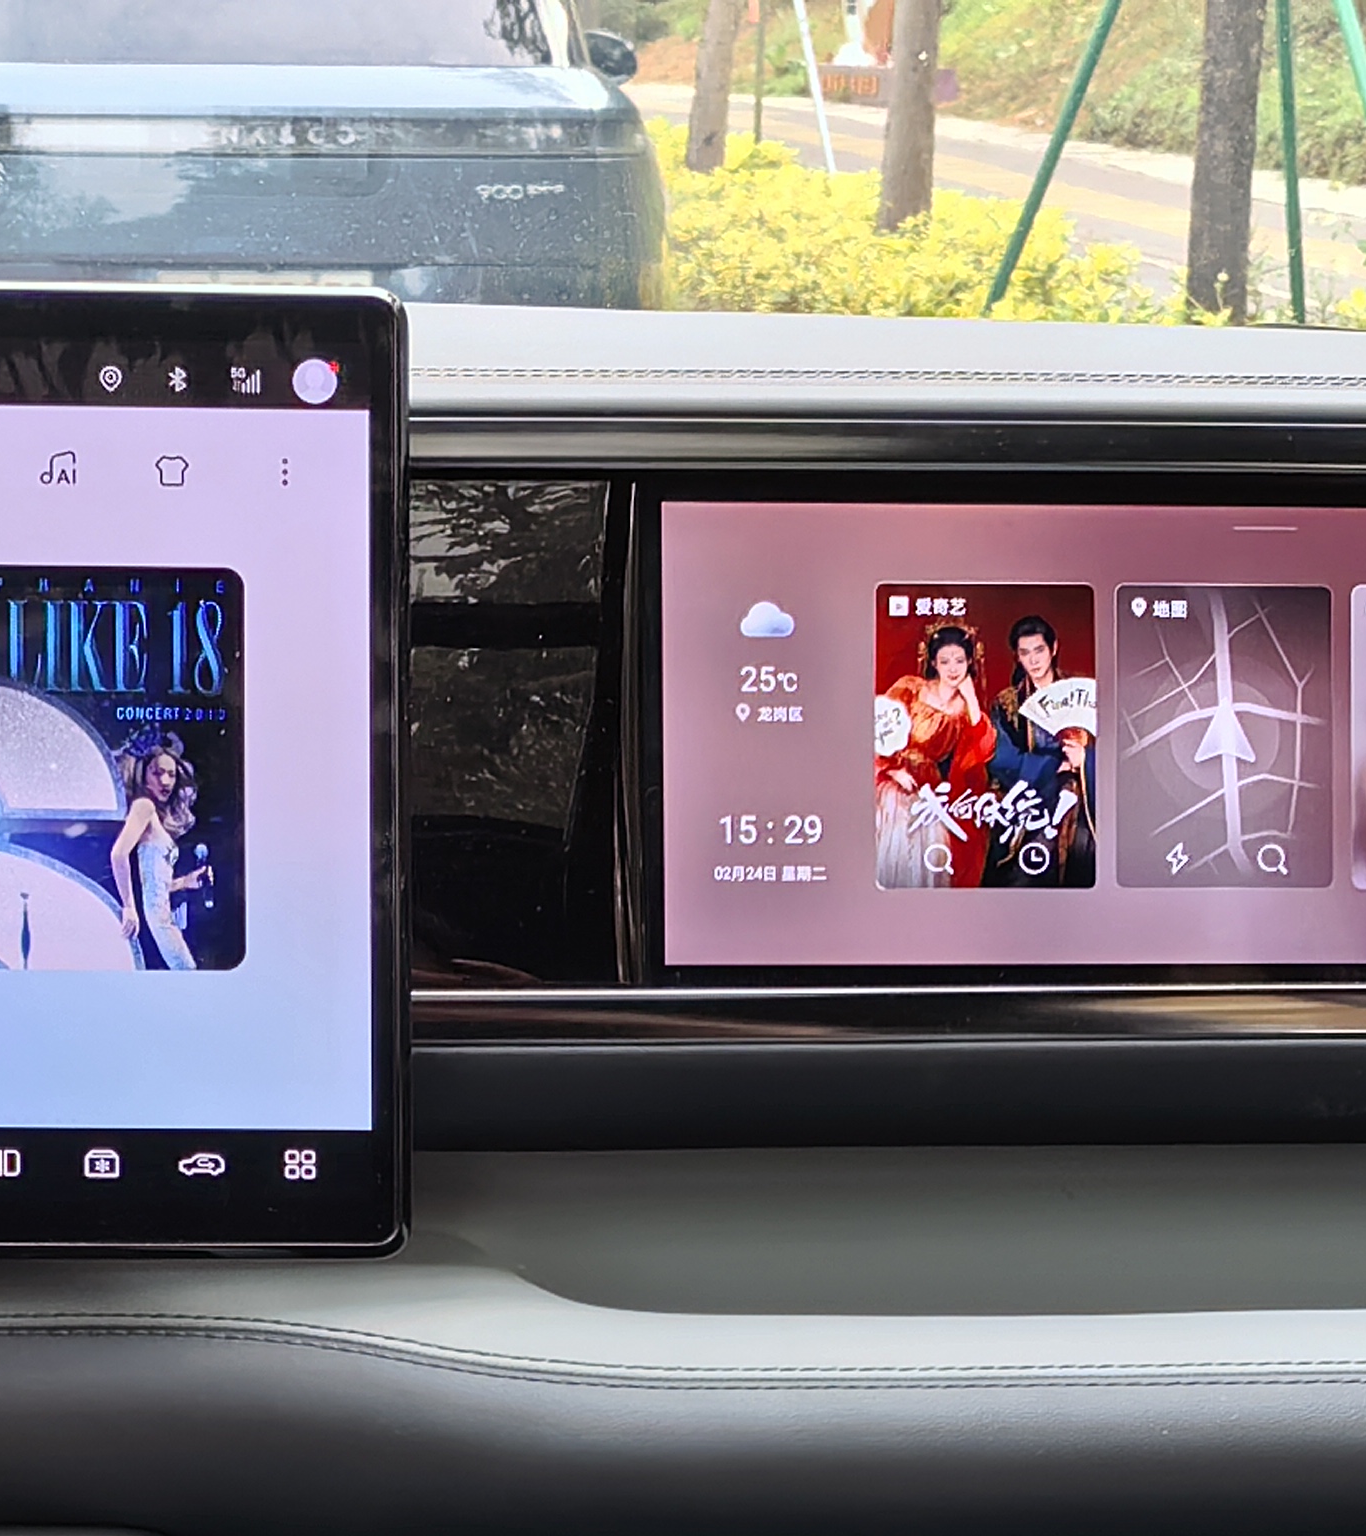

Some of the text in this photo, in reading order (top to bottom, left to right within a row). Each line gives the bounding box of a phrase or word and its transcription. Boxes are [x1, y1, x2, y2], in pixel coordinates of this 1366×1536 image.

[915, 597, 967, 616] 爱奇艺
[7, 600, 148, 693] LIKE
[167, 601, 224, 695] 18
[116, 706, 181, 721] CONCERT
[756, 706, 803, 723] 龙岗区
[719, 815, 823, 845] 15:29
[714, 866, 827, 883] 02月24日 星期二
